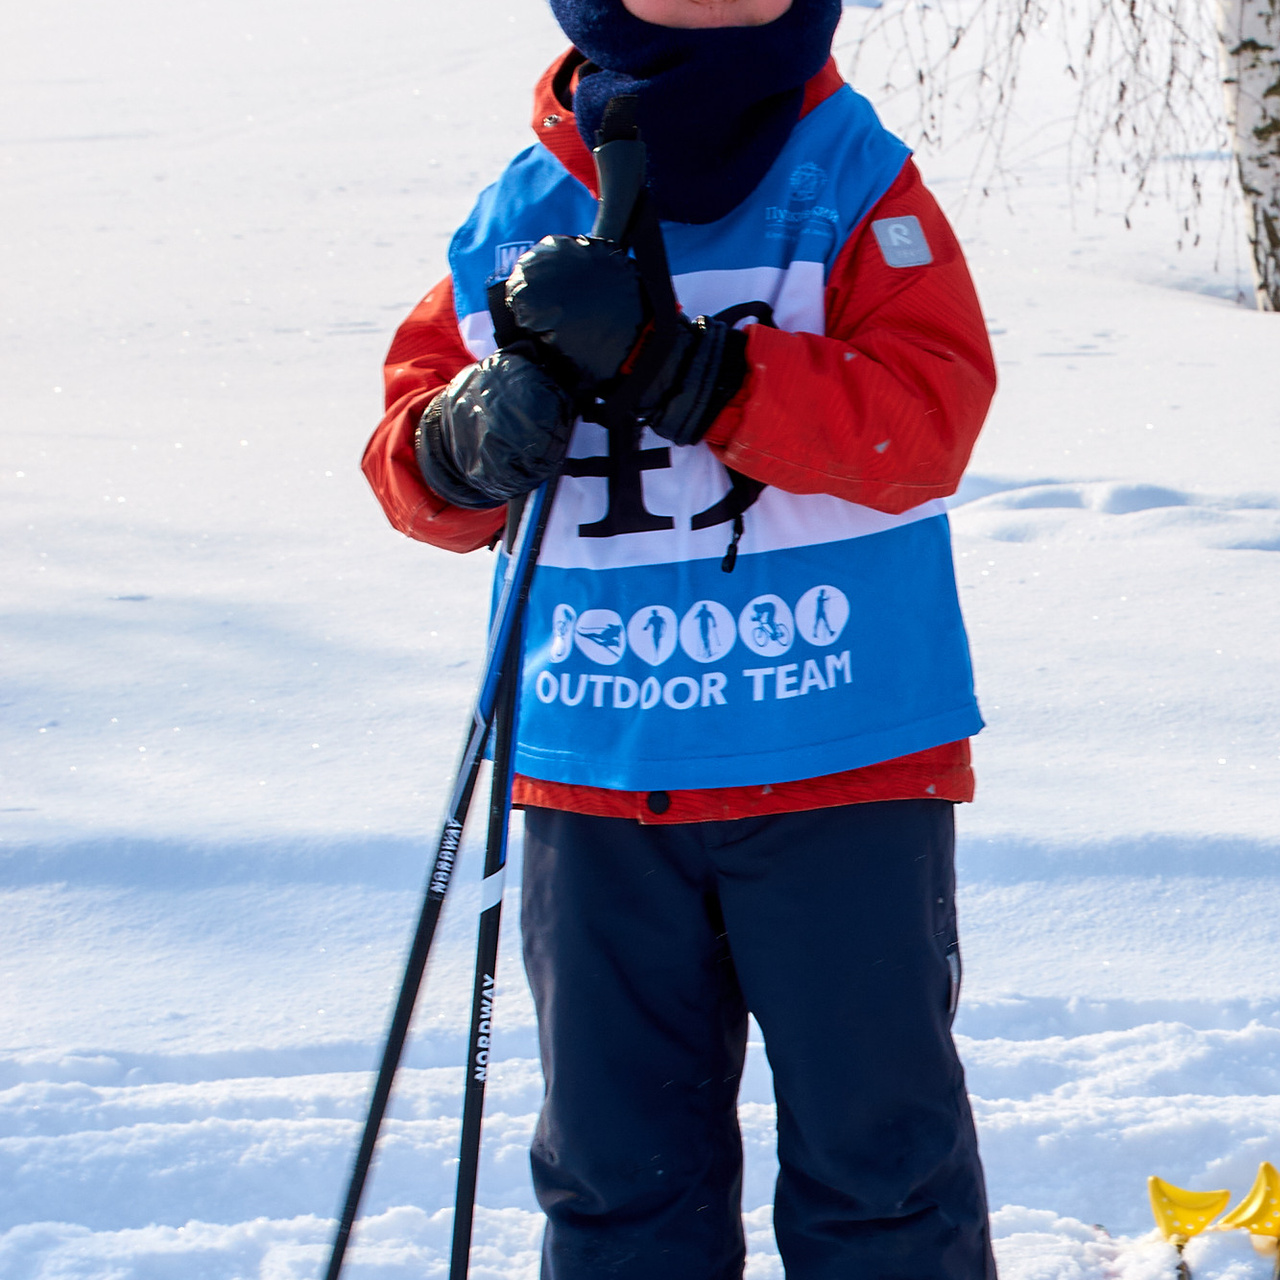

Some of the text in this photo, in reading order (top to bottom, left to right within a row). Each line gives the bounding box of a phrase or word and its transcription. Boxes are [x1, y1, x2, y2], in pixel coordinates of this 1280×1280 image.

[535, 649, 854, 711] OUTDOOR TEAM
[430, 817, 463, 895] NORDWAY
[474, 972, 496, 1083] NORDWAY
